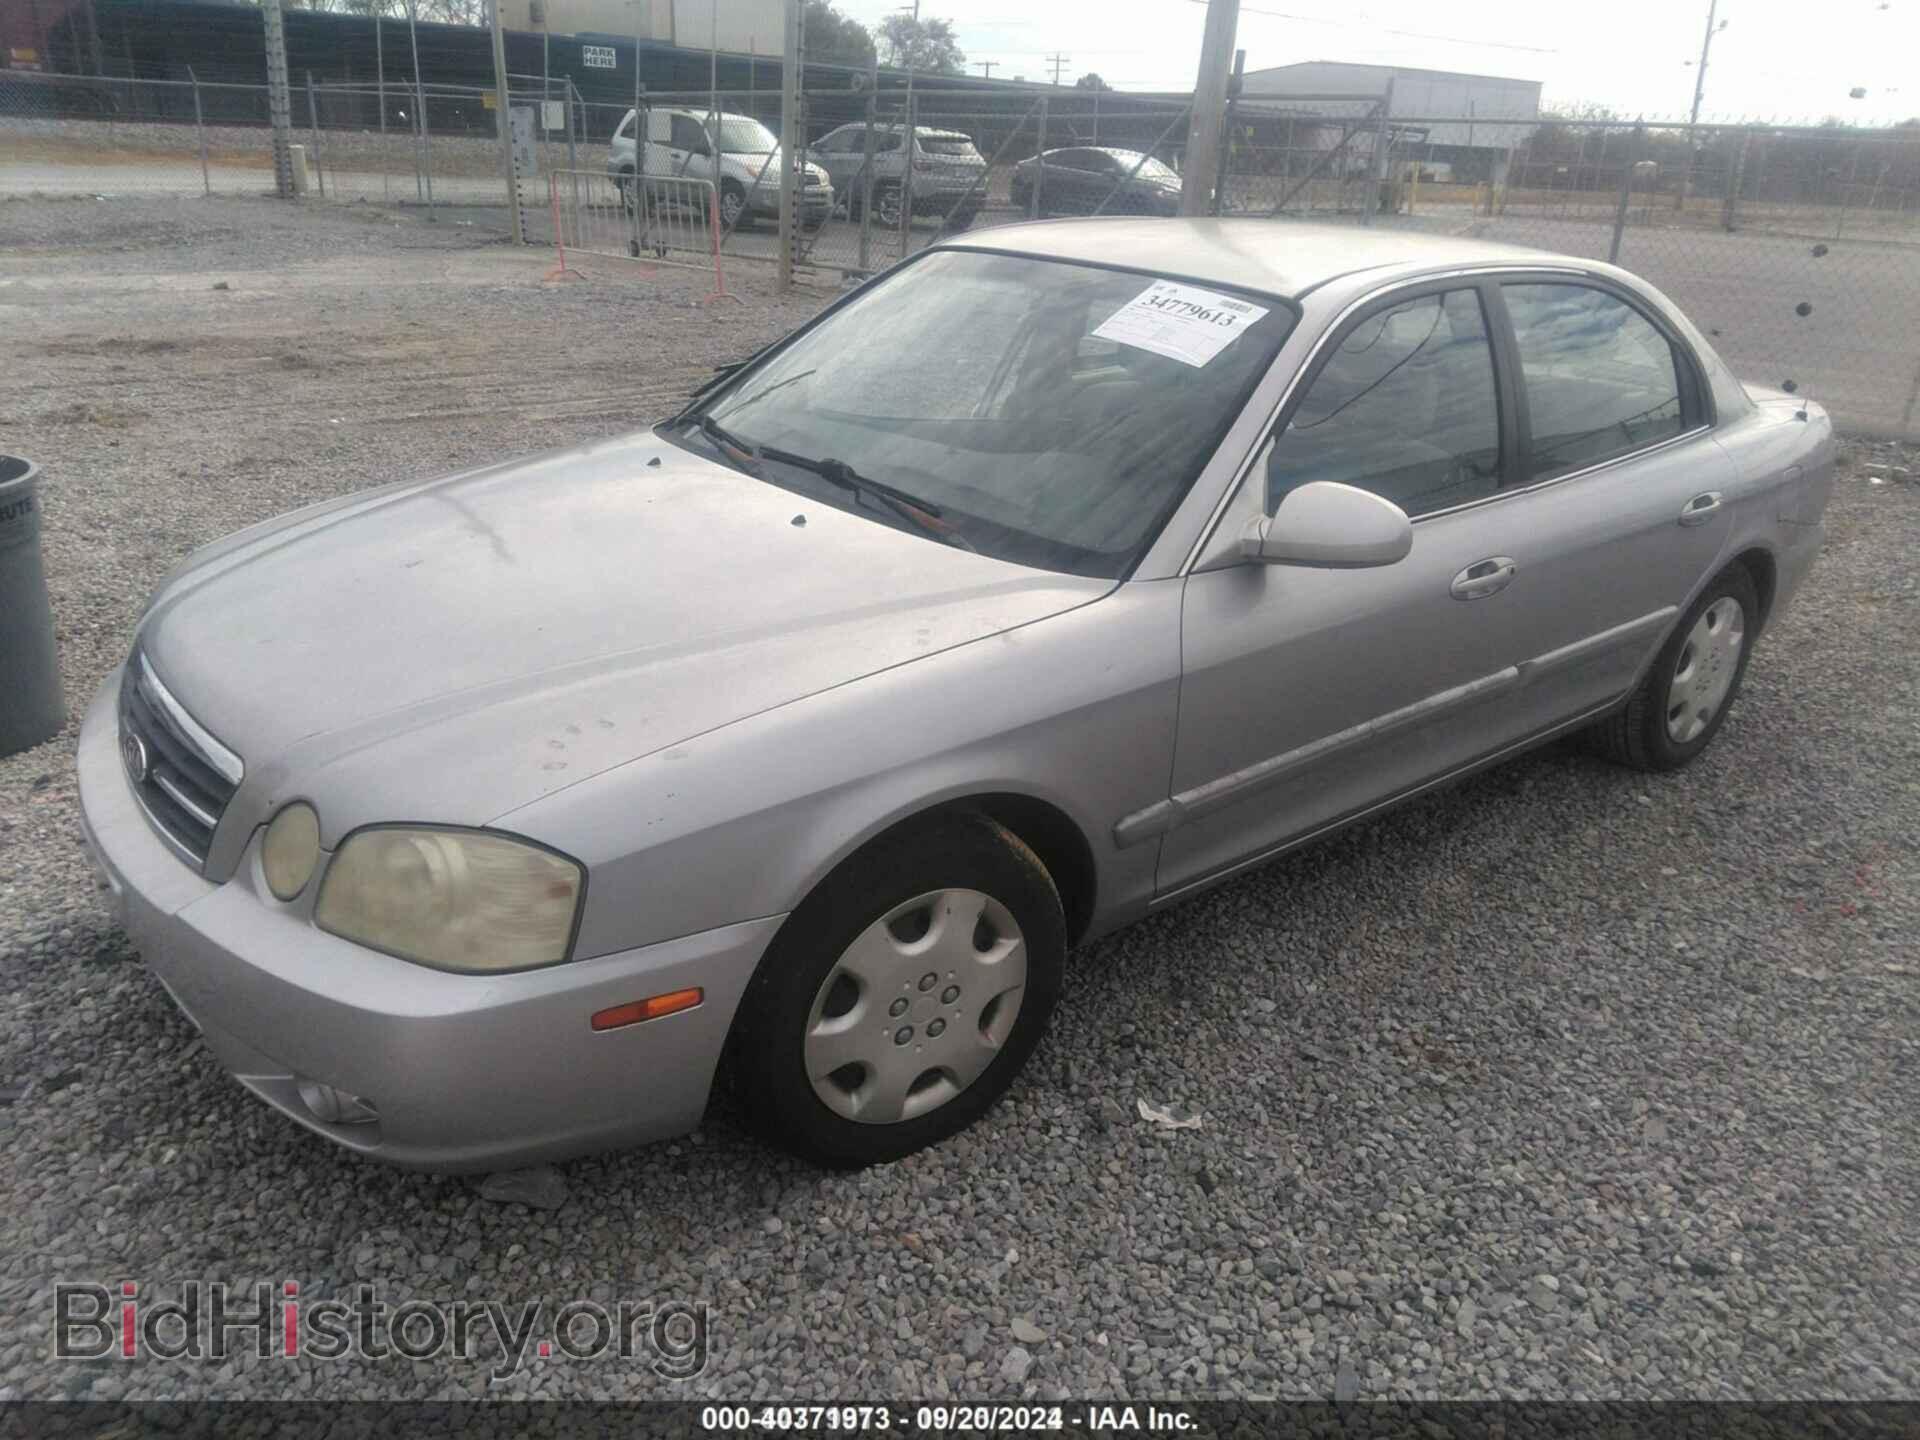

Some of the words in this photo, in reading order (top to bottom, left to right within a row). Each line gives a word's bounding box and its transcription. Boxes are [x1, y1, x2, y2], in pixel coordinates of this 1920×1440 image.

[584, 47, 615, 57] PARK
[584, 56, 615, 67] HERE
[1141, 295, 1237, 327] 34779613
